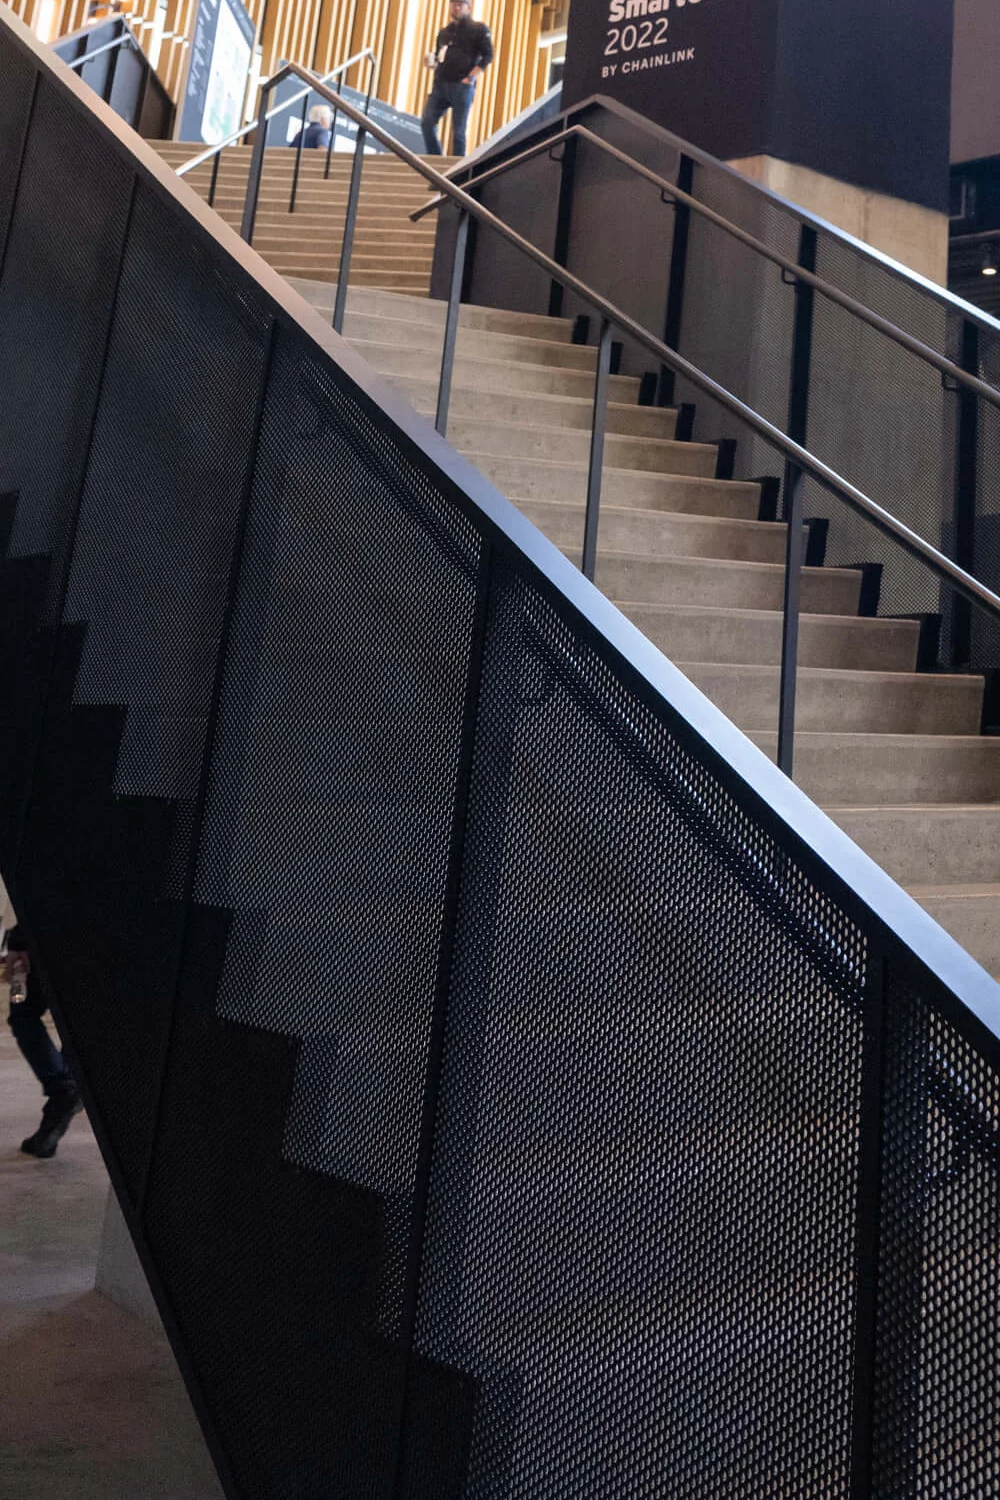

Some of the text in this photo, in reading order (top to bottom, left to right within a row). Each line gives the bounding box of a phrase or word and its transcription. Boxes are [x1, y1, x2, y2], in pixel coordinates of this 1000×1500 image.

[604, 18, 668, 56] 2022
[601, 47, 695, 78] BY CHAINLINK
